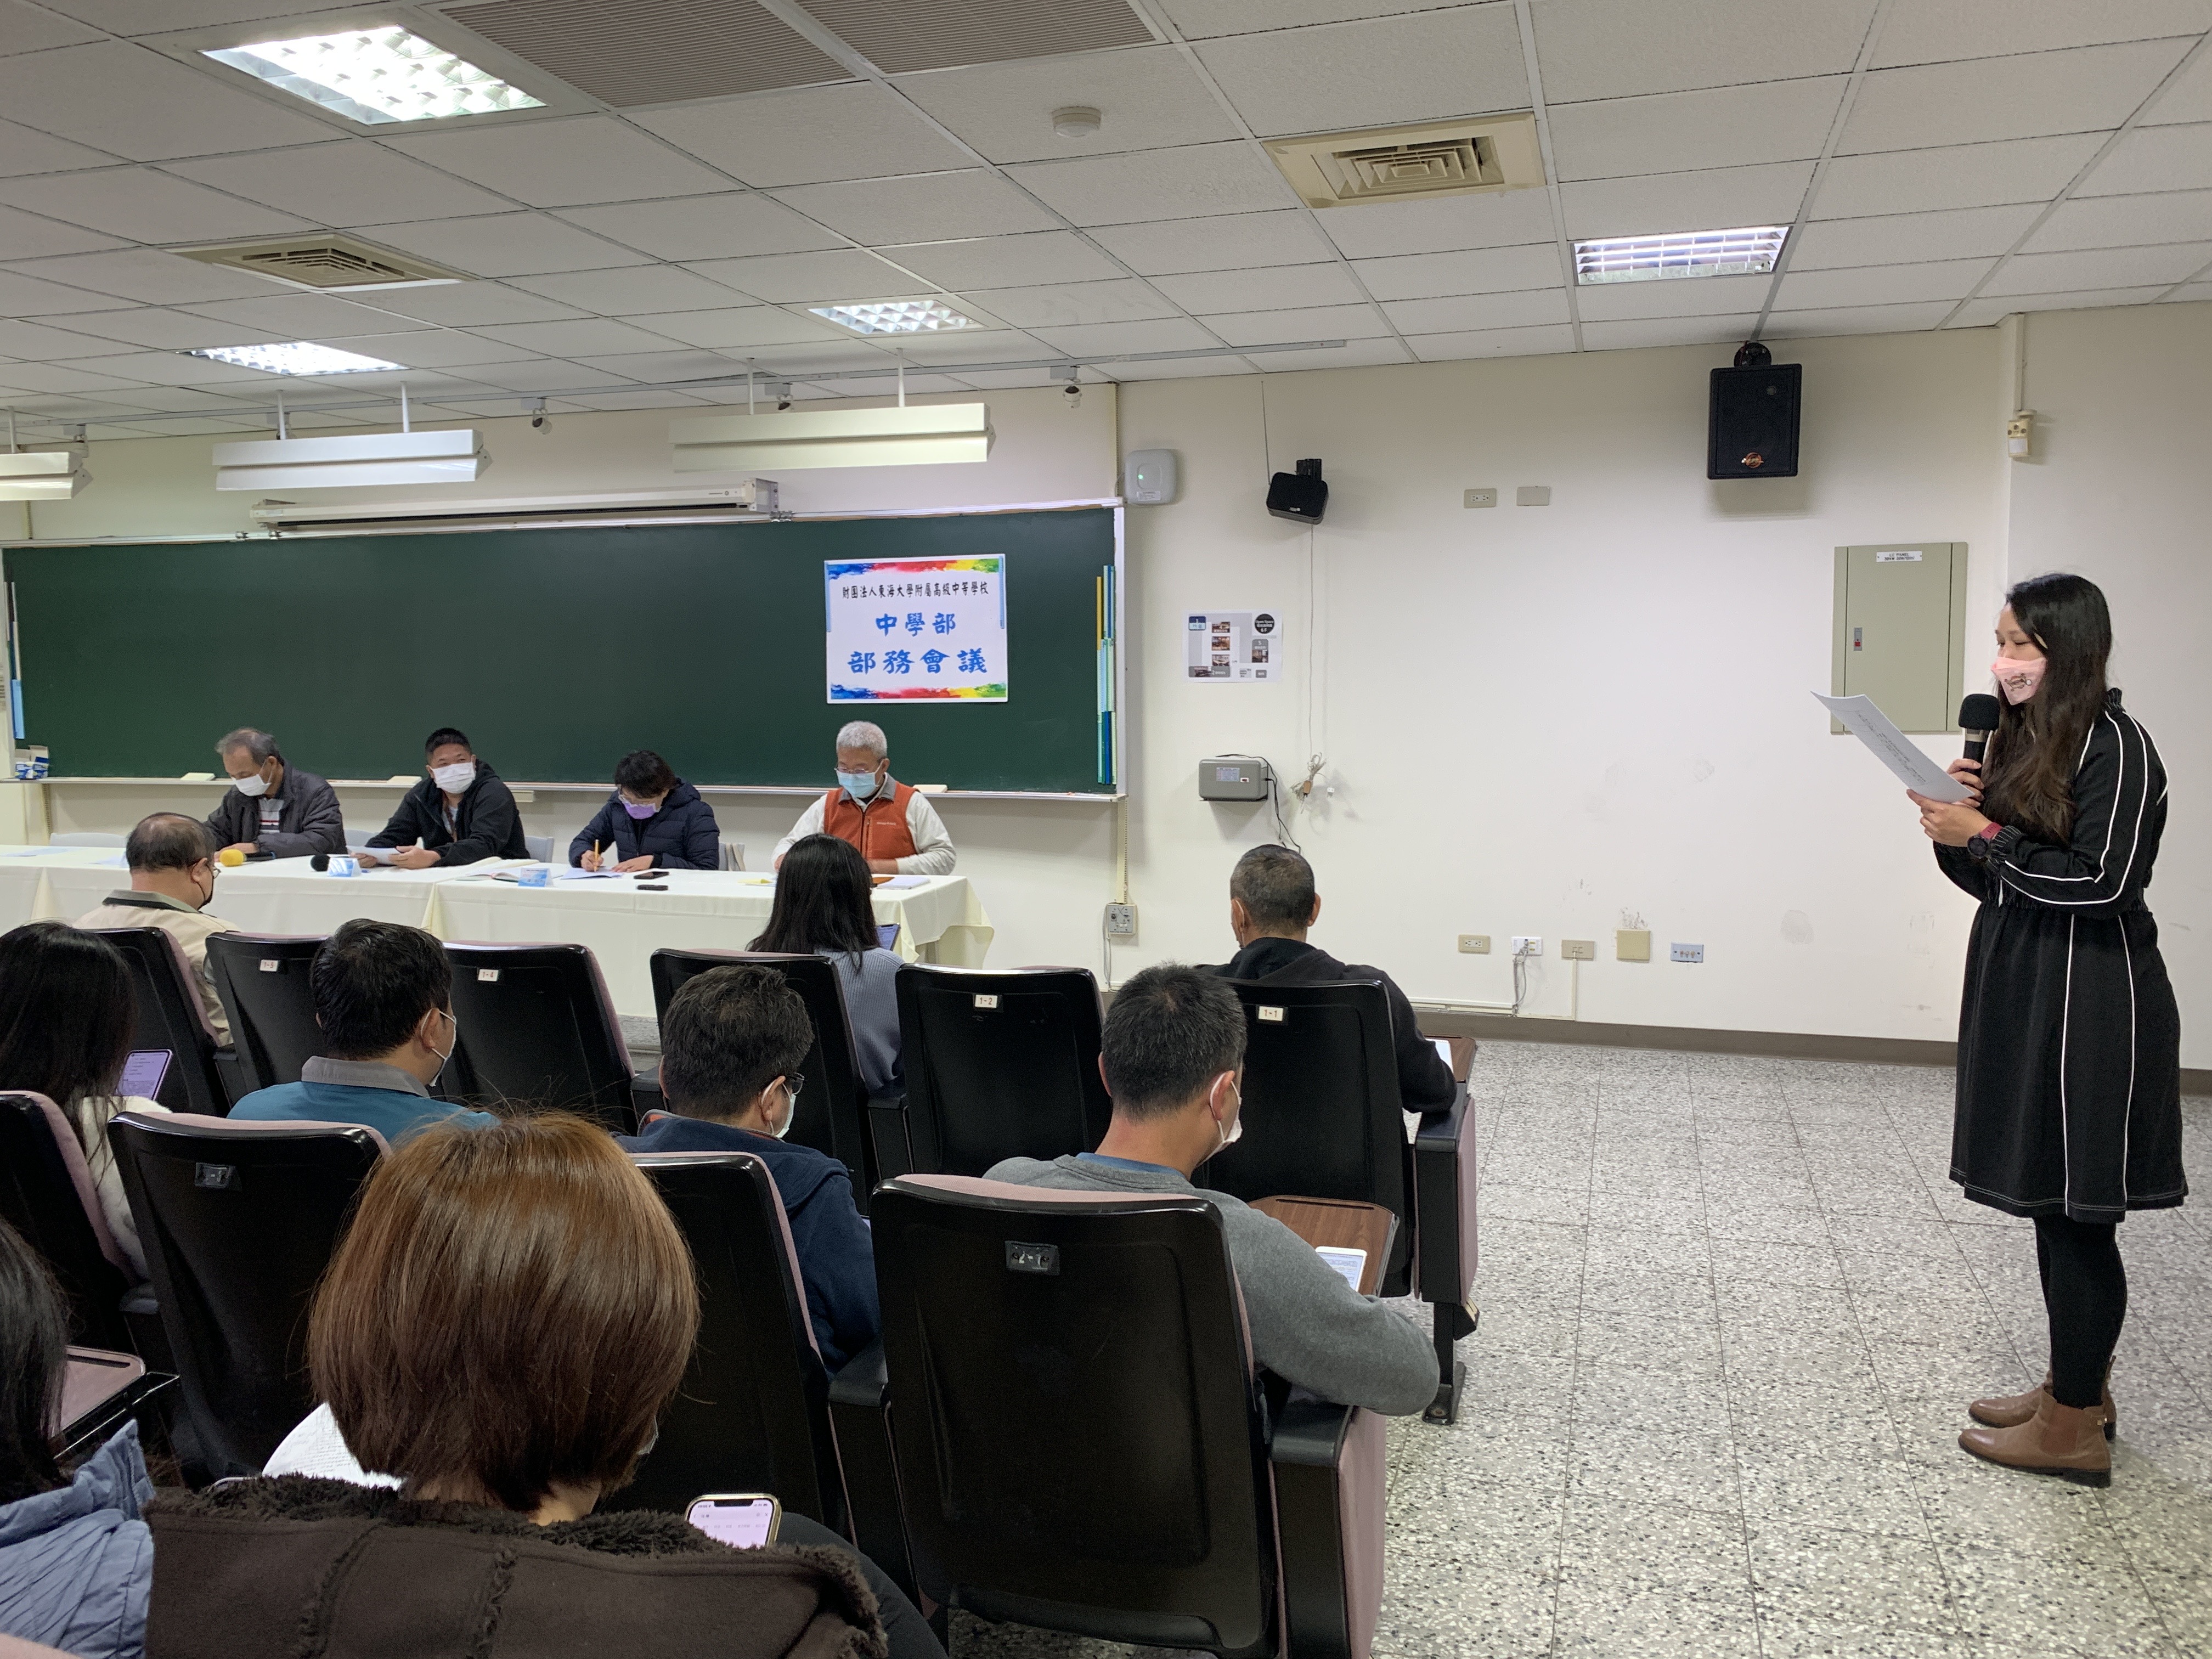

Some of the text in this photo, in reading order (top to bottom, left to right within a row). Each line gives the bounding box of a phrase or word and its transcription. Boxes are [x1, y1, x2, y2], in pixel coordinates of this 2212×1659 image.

[843, 581, 988, 599] 財團法人東海大學附屬高級中等學校
[876, 613, 956, 636] 中學部
[848, 648, 988, 674] 部務會議
[1264, 1009, 1277, 1018] 1-1
